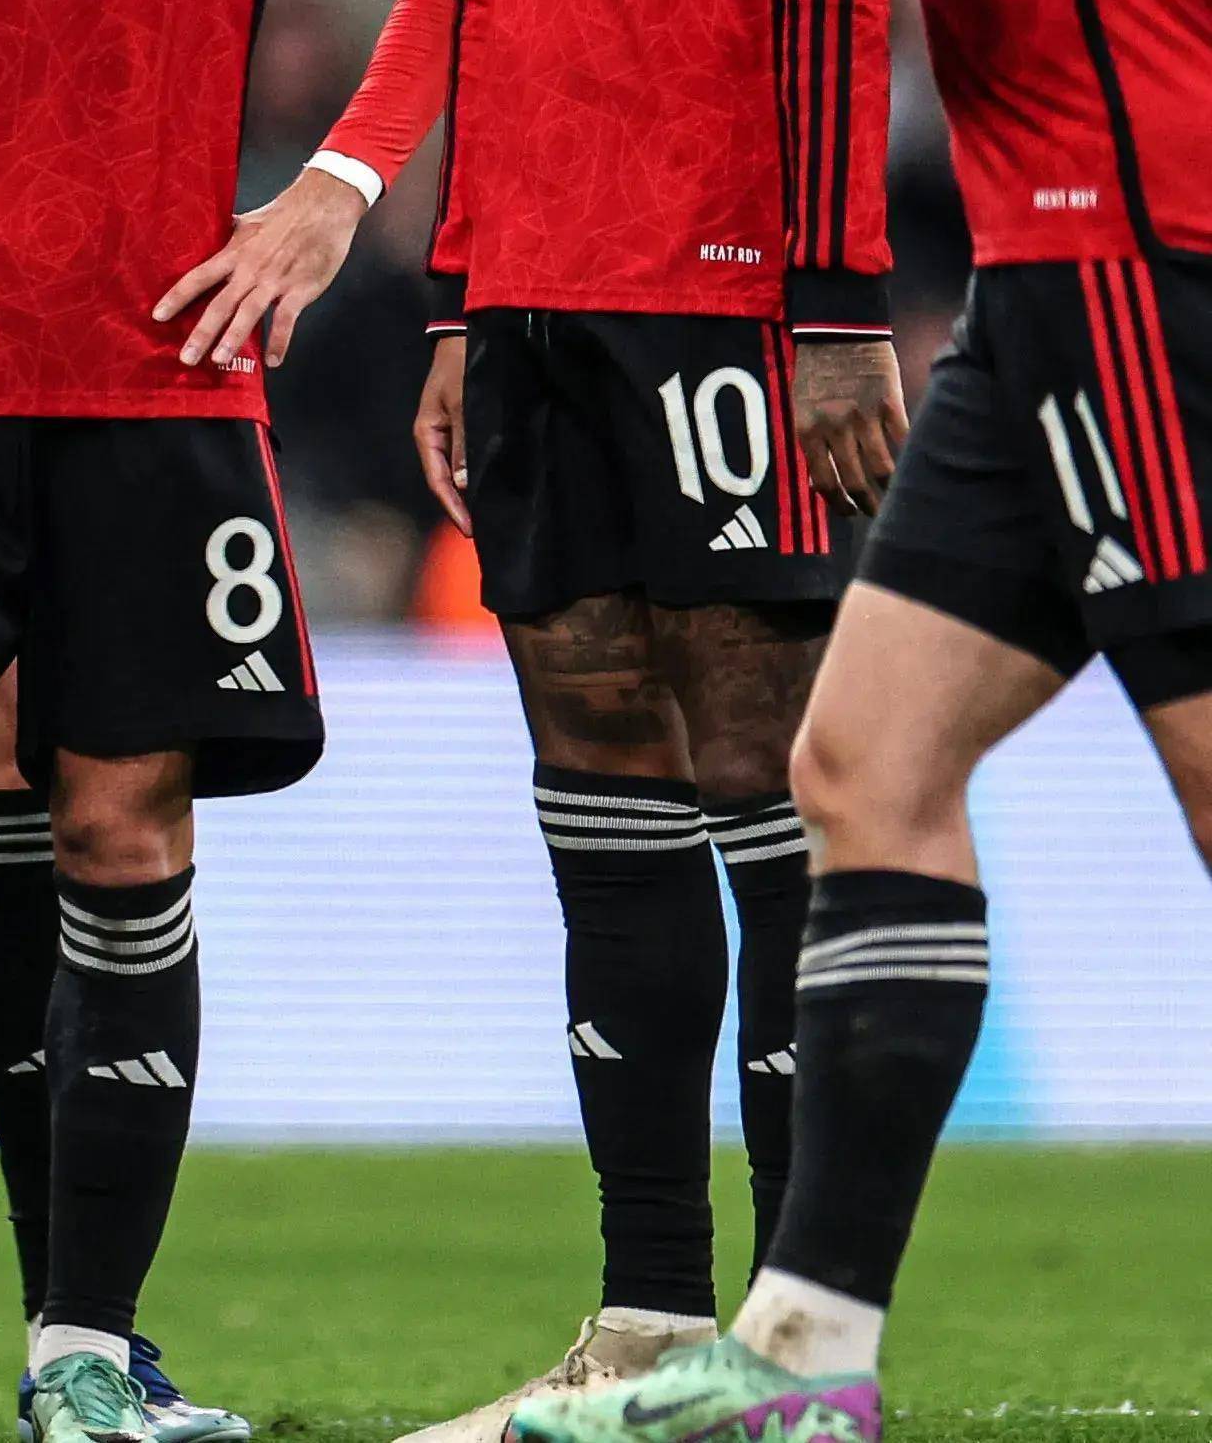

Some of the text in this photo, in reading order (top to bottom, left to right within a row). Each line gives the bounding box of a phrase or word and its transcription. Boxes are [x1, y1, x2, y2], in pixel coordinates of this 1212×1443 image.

[658, 366, 770, 505] 10
[1038, 387, 1128, 535] 11
[205, 516, 283, 644] 8
